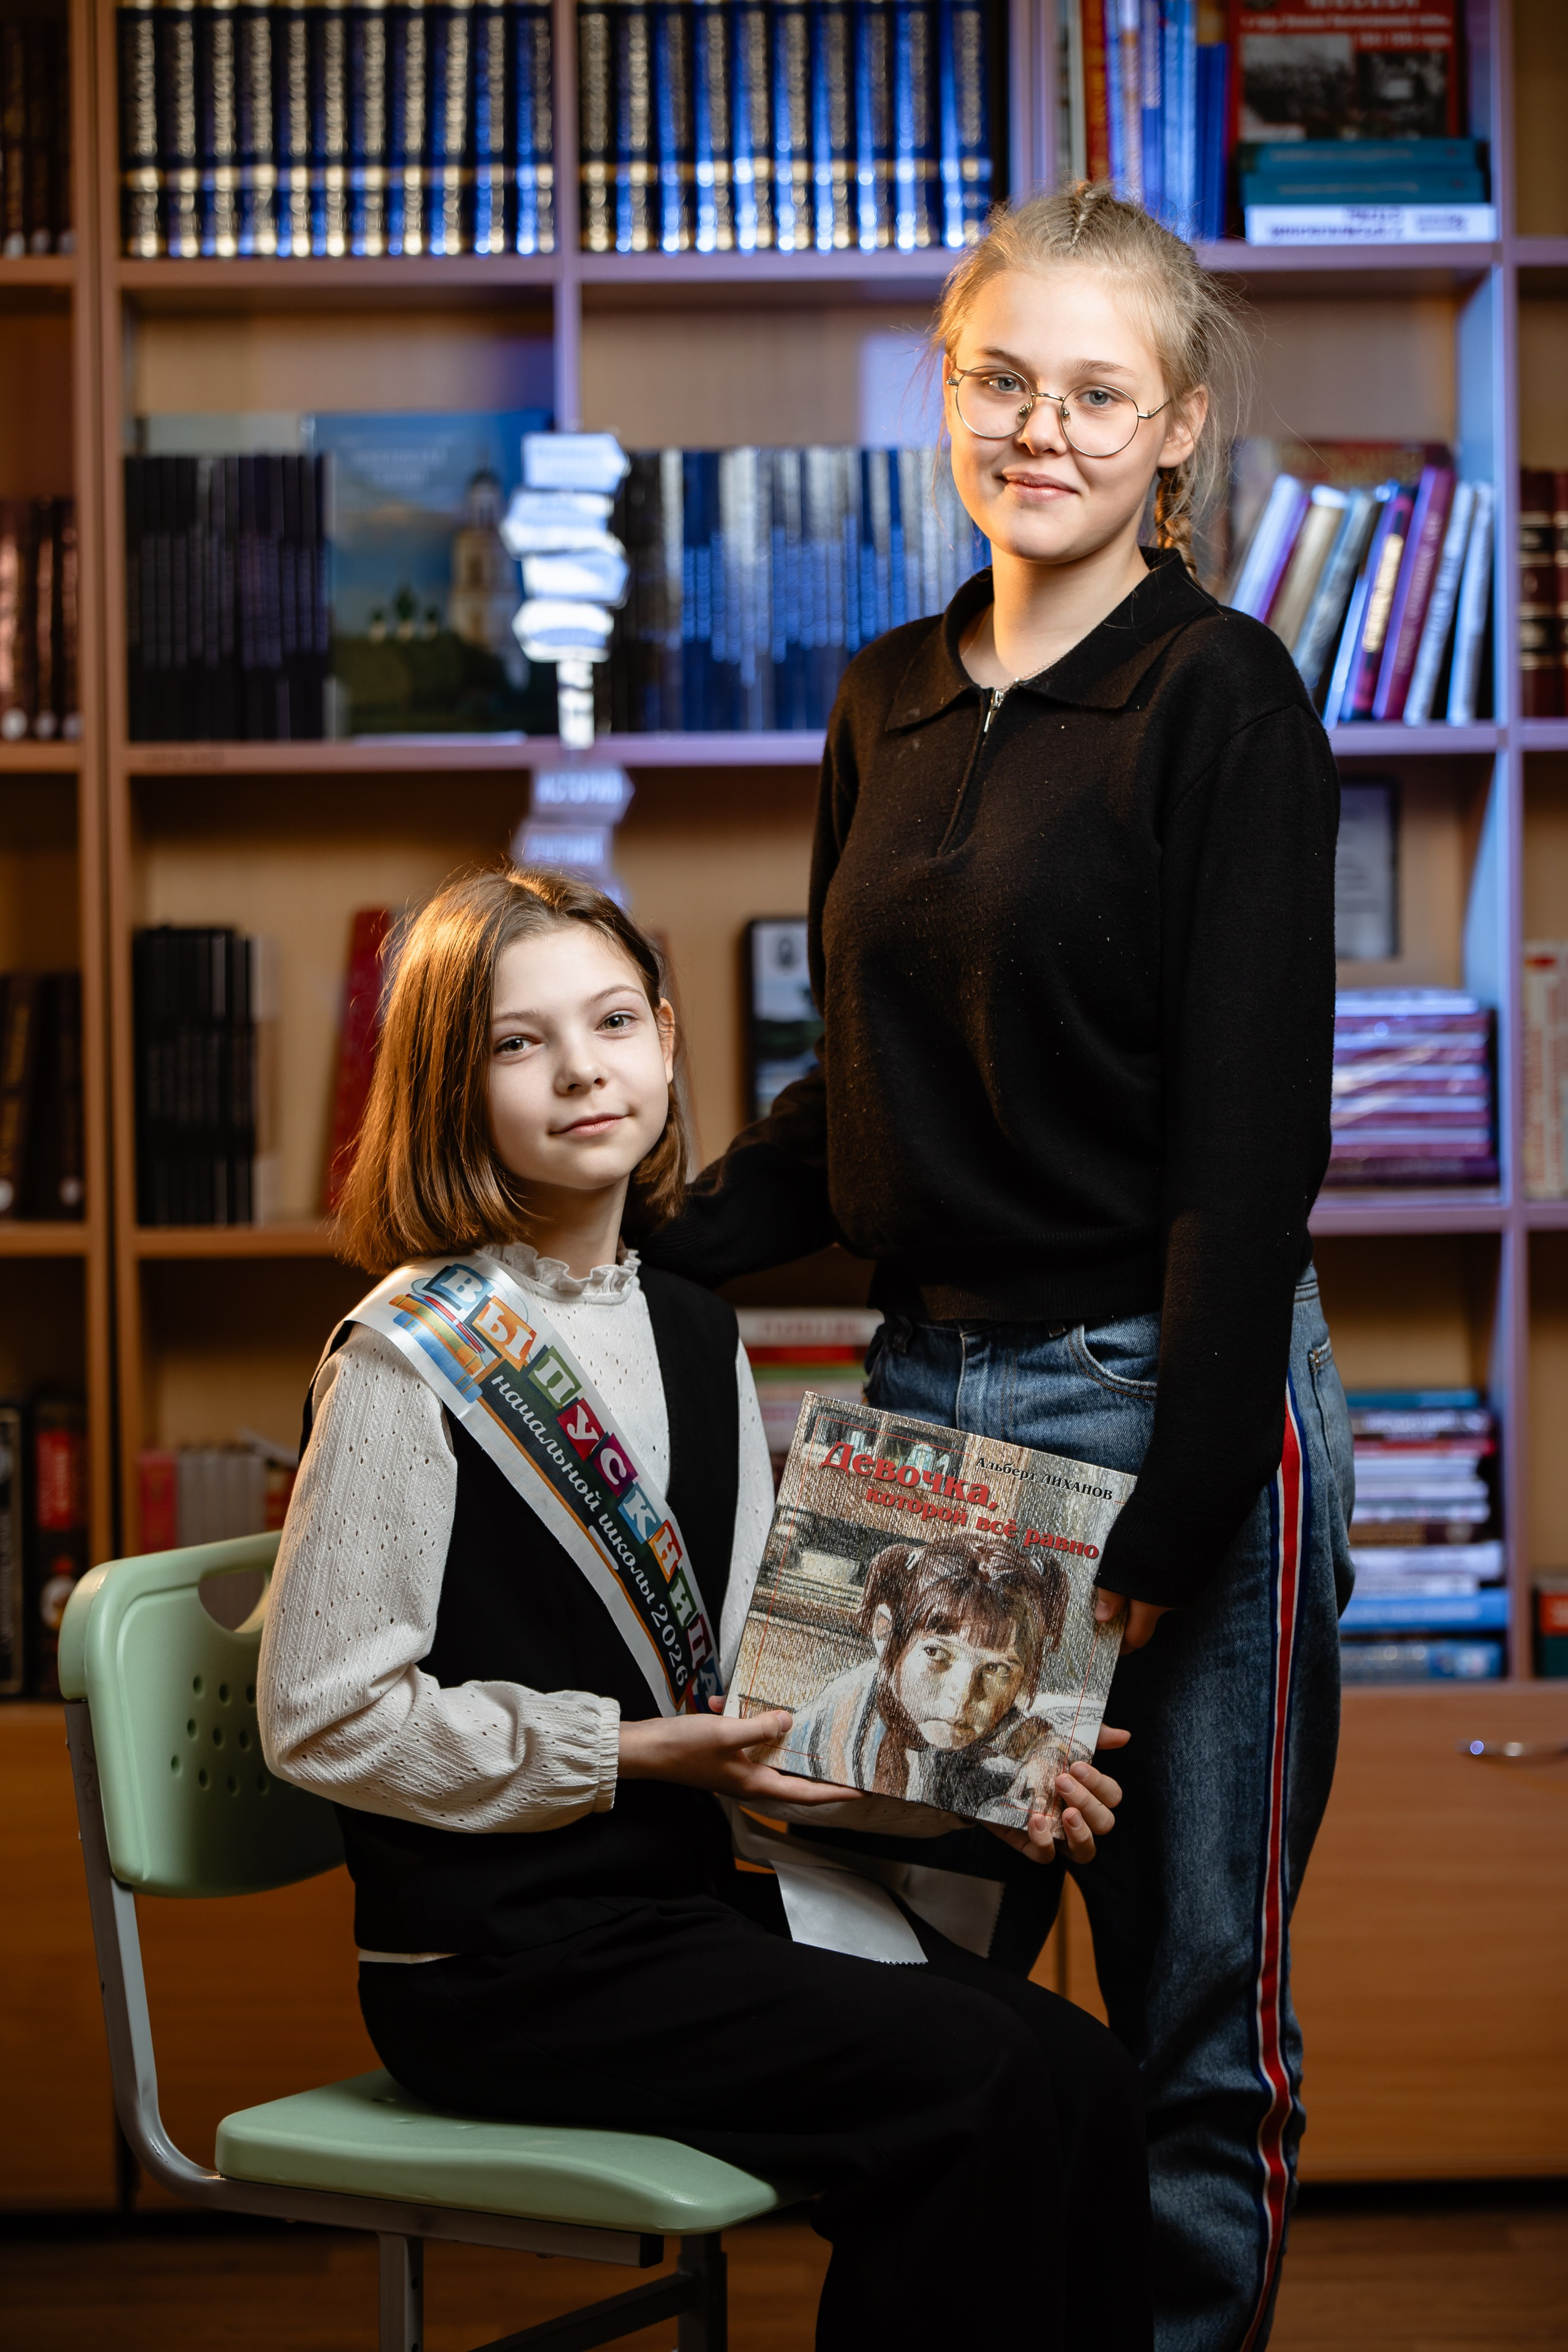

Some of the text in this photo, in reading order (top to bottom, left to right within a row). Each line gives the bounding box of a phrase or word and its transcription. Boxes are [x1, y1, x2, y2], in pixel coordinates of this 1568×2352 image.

[440, 1268, 718, 1700] ВЫПУСКНИЦА
[820, 1441, 1000, 1512] Девочка,
[975, 1457, 1113, 1500] Альберт ЛИХАНОВ
[491, 1374, 688, 1687] начальной школы 2026
[866, 1488, 1100, 1559] которой всё равно
